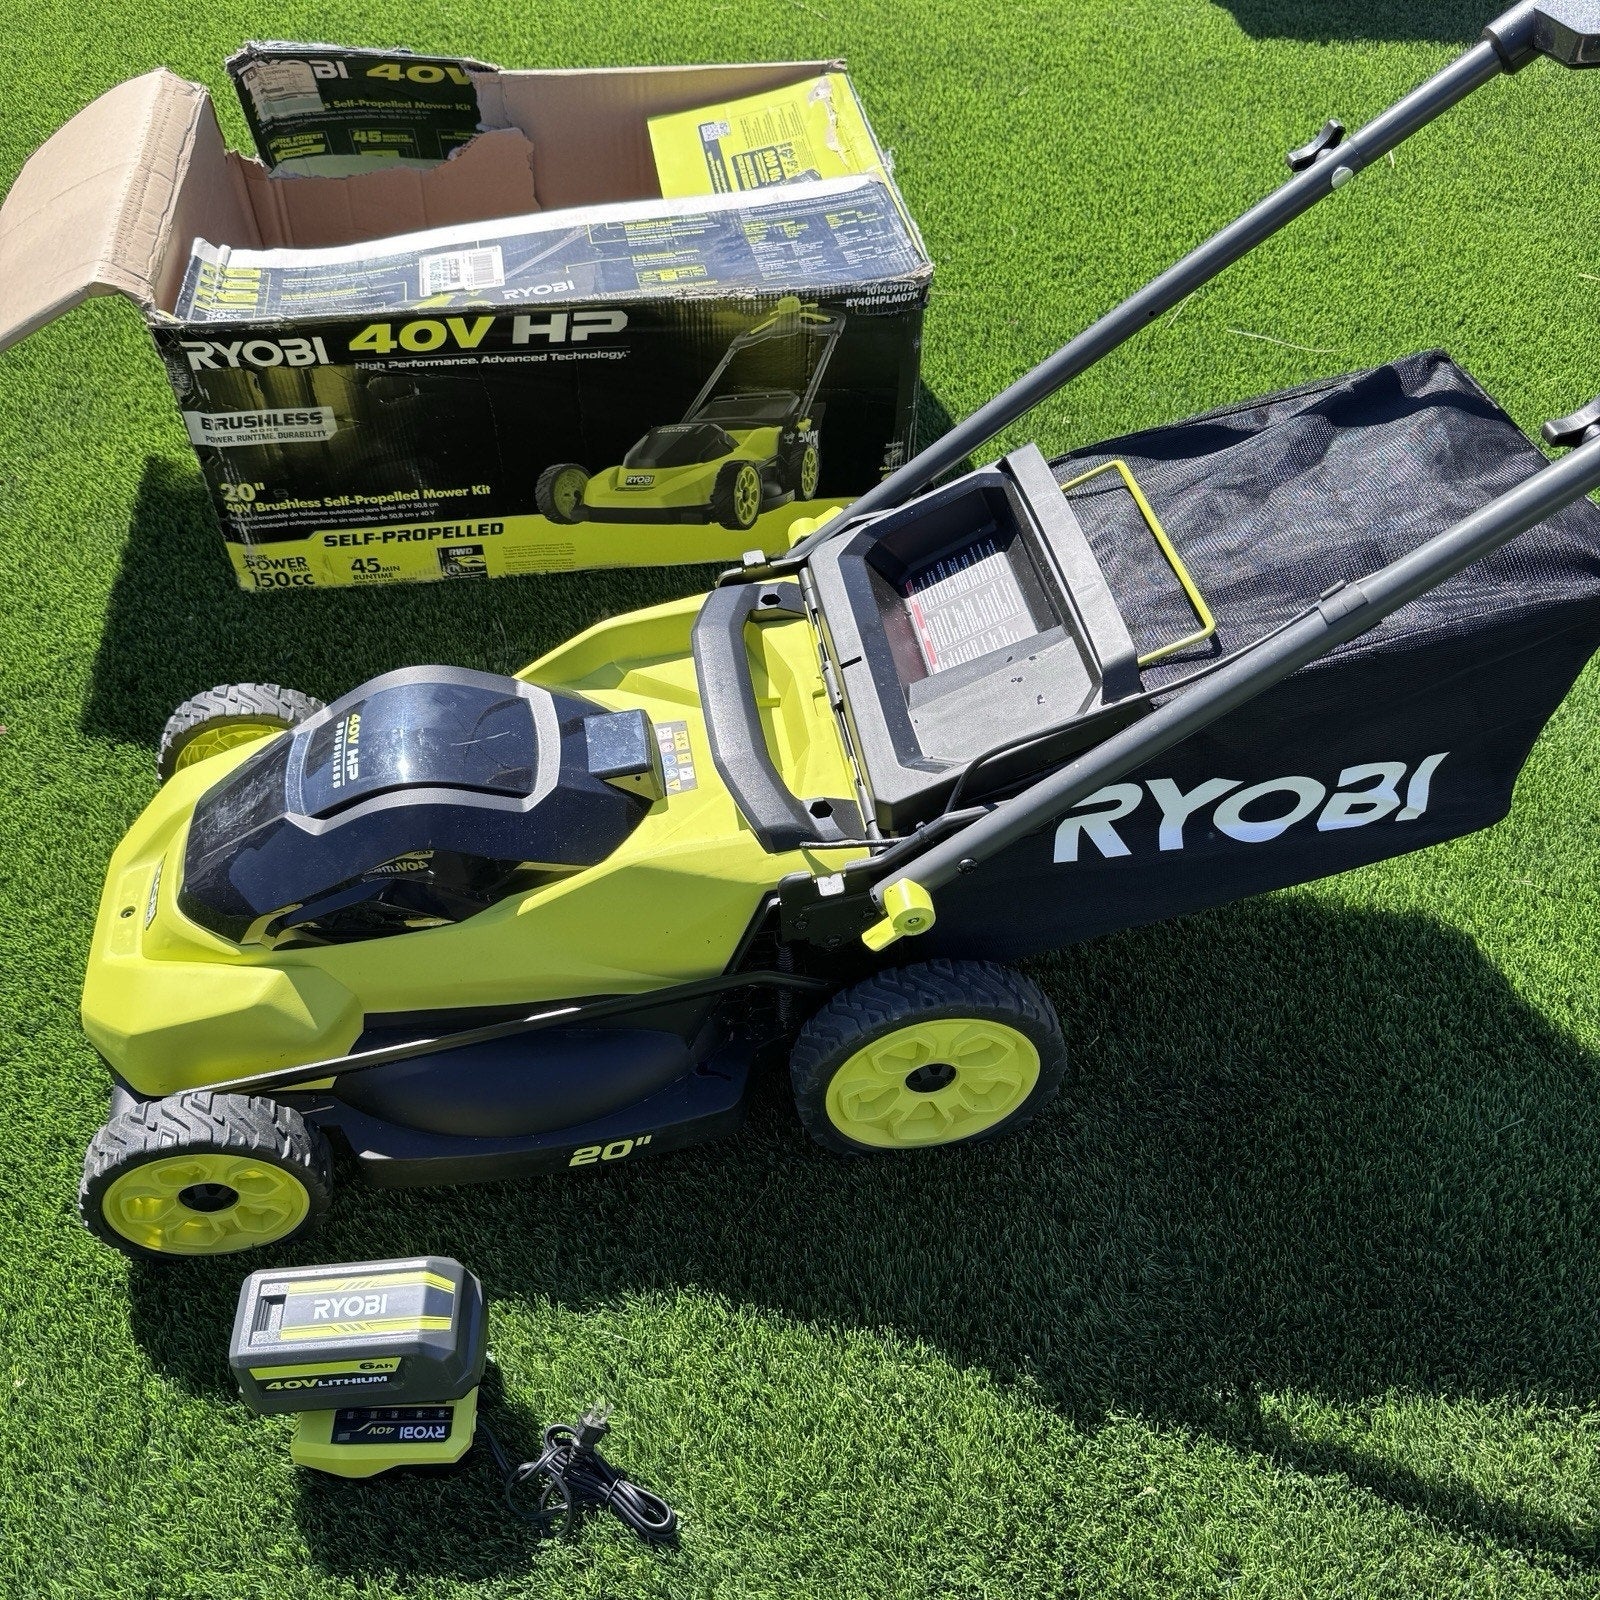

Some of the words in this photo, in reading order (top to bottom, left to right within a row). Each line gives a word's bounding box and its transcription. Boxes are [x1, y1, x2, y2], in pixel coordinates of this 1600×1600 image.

[333, 100, 412, 109] Self-Propelled
[414, 101, 453, 110] Mower
[455, 103, 471, 111] Kit
[502, 280, 575, 300] RYOBI
[845, 290, 919, 307] RY40HPLM07K
[179, 337, 330, 371] RYOBI
[348, 316, 496, 353] 40V
[512, 310, 629, 345] HP
[355, 361, 386, 371] High
[388, 357, 478, 369] Performance.
[481, 353, 548, 364] Advanced
[201, 411, 324, 431] BRUSHLESS
[236, 433, 276, 442] RUNTIME.
[277, 430, 329, 440] DURABILITY.
[250, 426, 280, 434] MORE
[626, 475, 654, 484] RYOBI
[219, 482, 266, 502] 20"
[226, 503, 252, 514] 40V
[254, 498, 322, 512] Brushless
[323, 490, 420, 507] Self-Propelled
[422, 486, 469, 499] Mower
[472, 485, 491, 496] Kit
[323, 522, 505, 548] SELF-PROPELLED
[448, 547, 474, 556] RWD
[244, 556, 307, 571] POWER
[351, 557, 382, 574] 45
[381, 565, 401, 573] MIN
[250, 571, 316, 588] 150cc
[353, 572, 395, 581] RUNTIME
[347, 713, 361, 745] 40V
[332, 721, 345, 789] BRUSHLESS
[346, 747, 359, 781] HP
[1053, 751, 1450, 864] RYOBI
[568, 1134, 652, 1167] 20"
[313, 1293, 388, 1320] RYOBI
[359, 1361, 394, 1371] 6Ah
[366, 1425, 395, 1435] 40V
[399, 1425, 446, 1439] RYOBI
